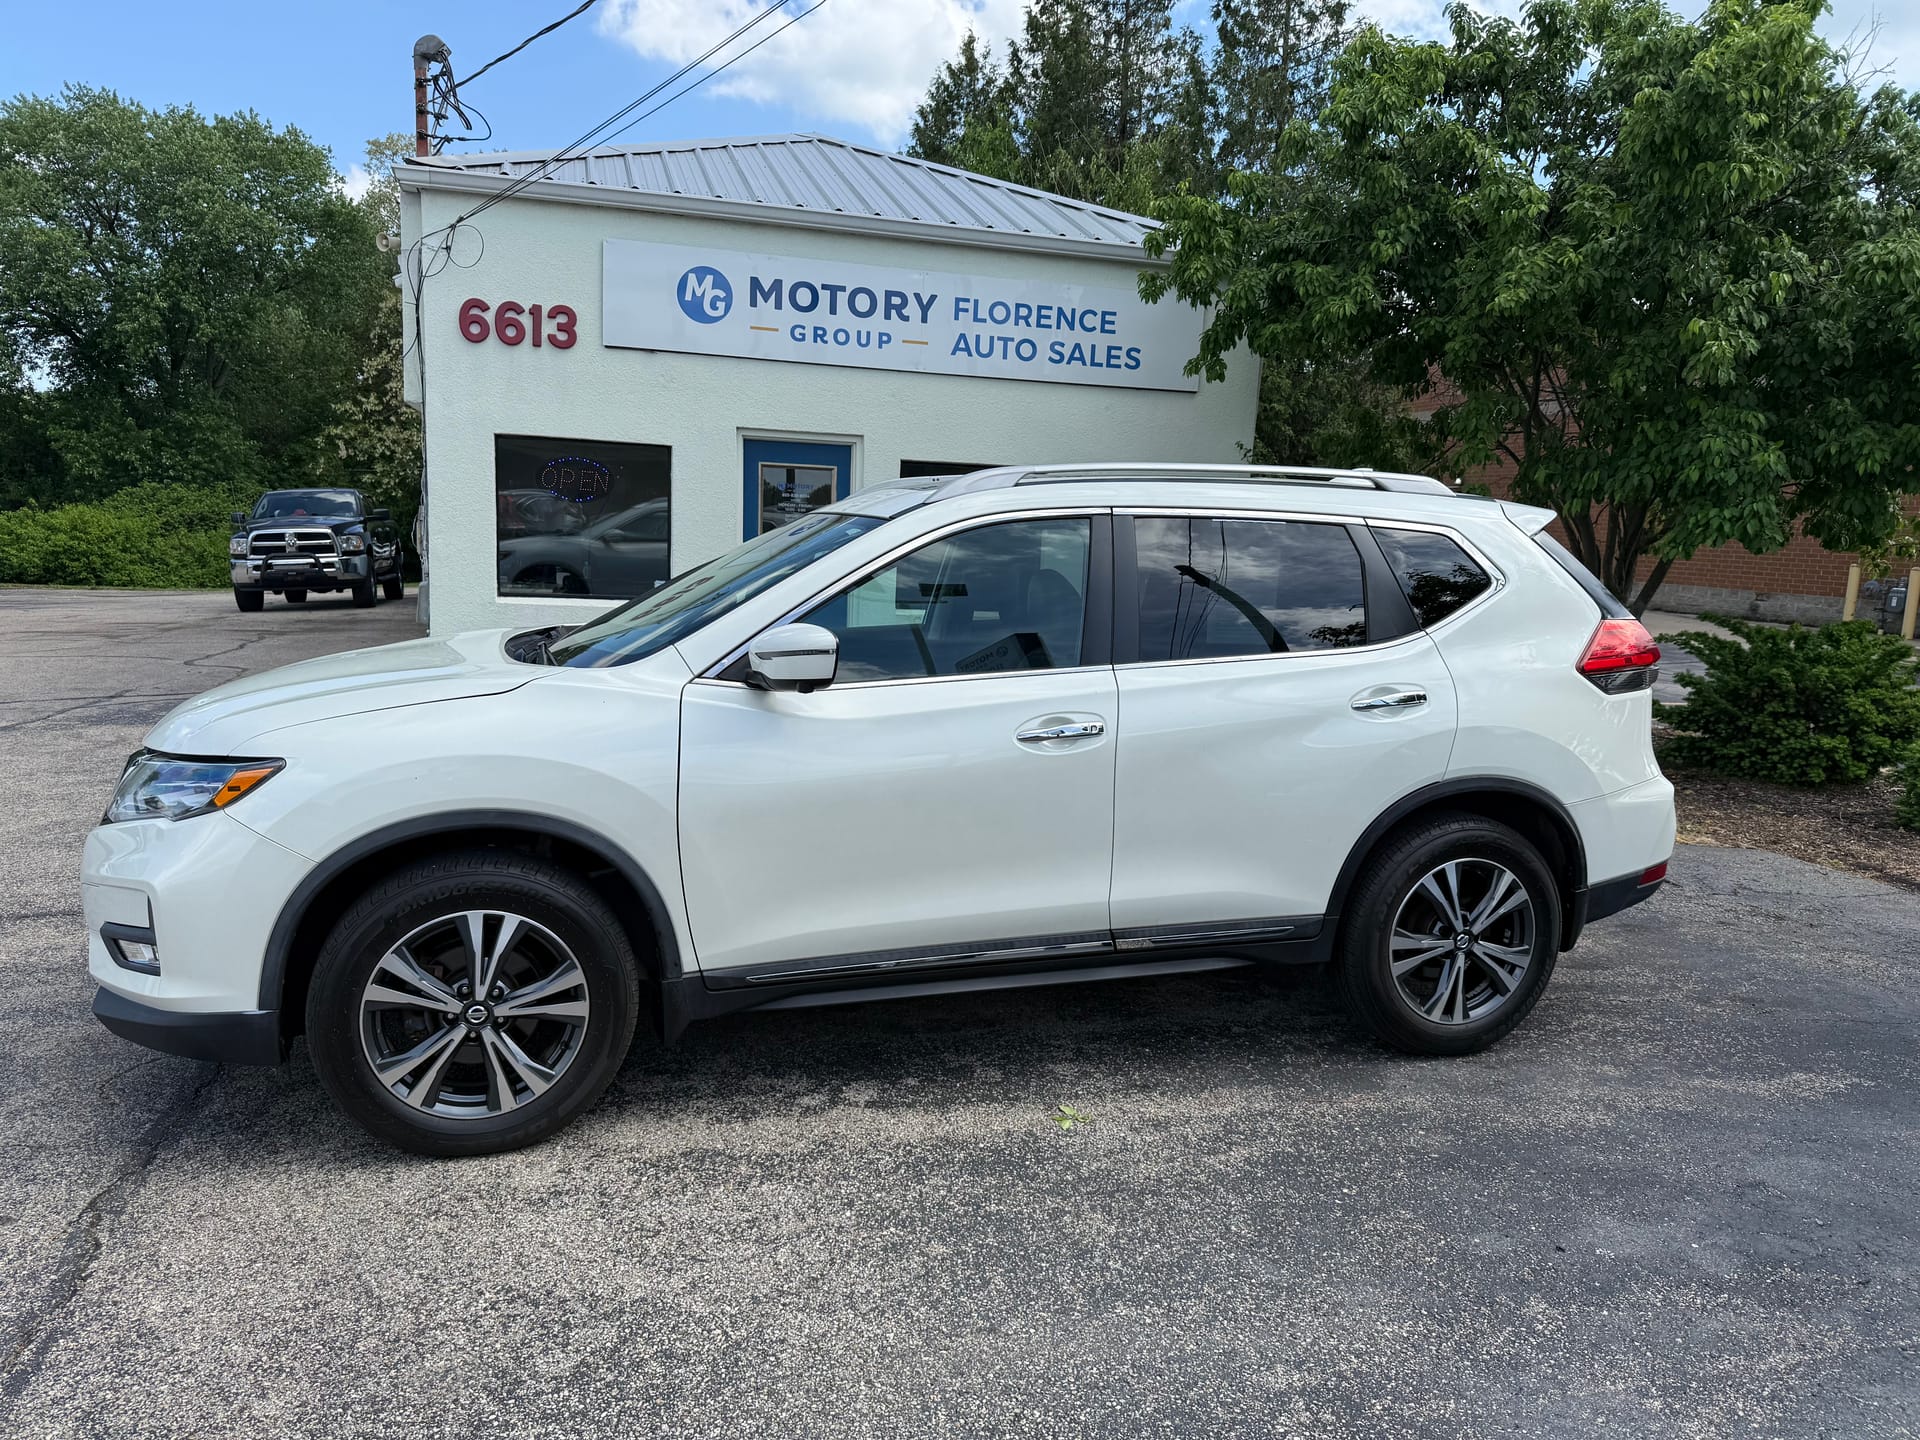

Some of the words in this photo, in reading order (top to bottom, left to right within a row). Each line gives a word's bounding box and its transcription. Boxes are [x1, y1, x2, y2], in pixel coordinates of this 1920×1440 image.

[684, 272, 727, 318] MG
[749, 276, 938, 324] MOTORY
[458, 297, 578, 350] 6613
[953, 296, 1118, 335] FLORENCE
[789, 324, 893, 350] GROUP
[950, 332, 1038, 362] AUTO
[1047, 341, 1142, 371] SALES
[541, 467, 610, 494] OPEN
